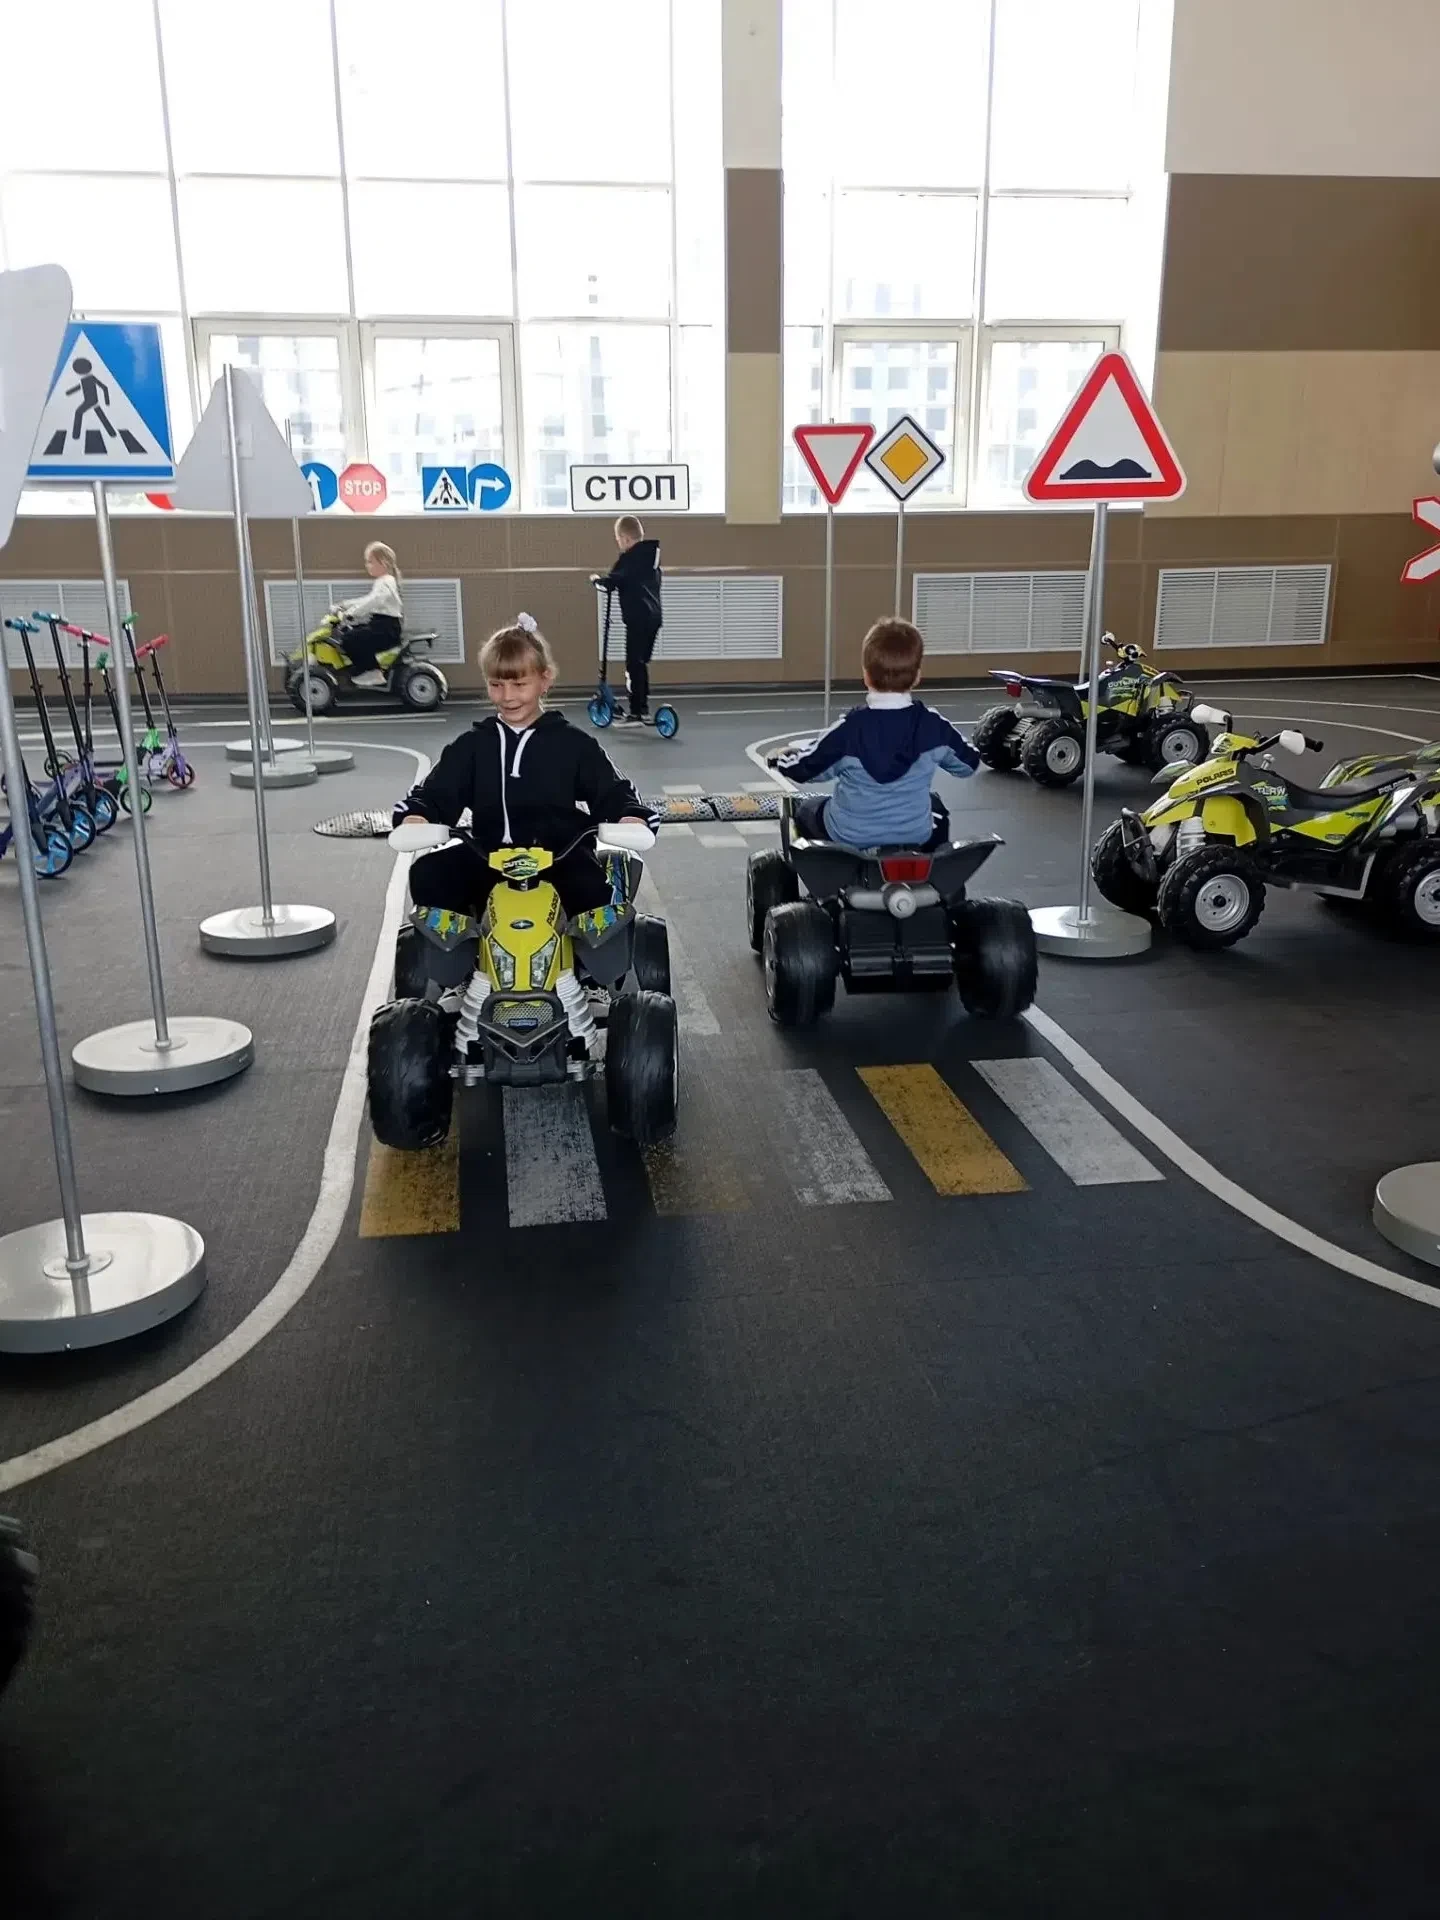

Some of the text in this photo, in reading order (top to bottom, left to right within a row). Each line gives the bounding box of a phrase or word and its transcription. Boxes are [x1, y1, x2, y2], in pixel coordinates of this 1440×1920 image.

[344, 479, 382, 496] STOP
[585, 475, 676, 501] СТОП
[1196, 767, 1235, 786] POLARIS
